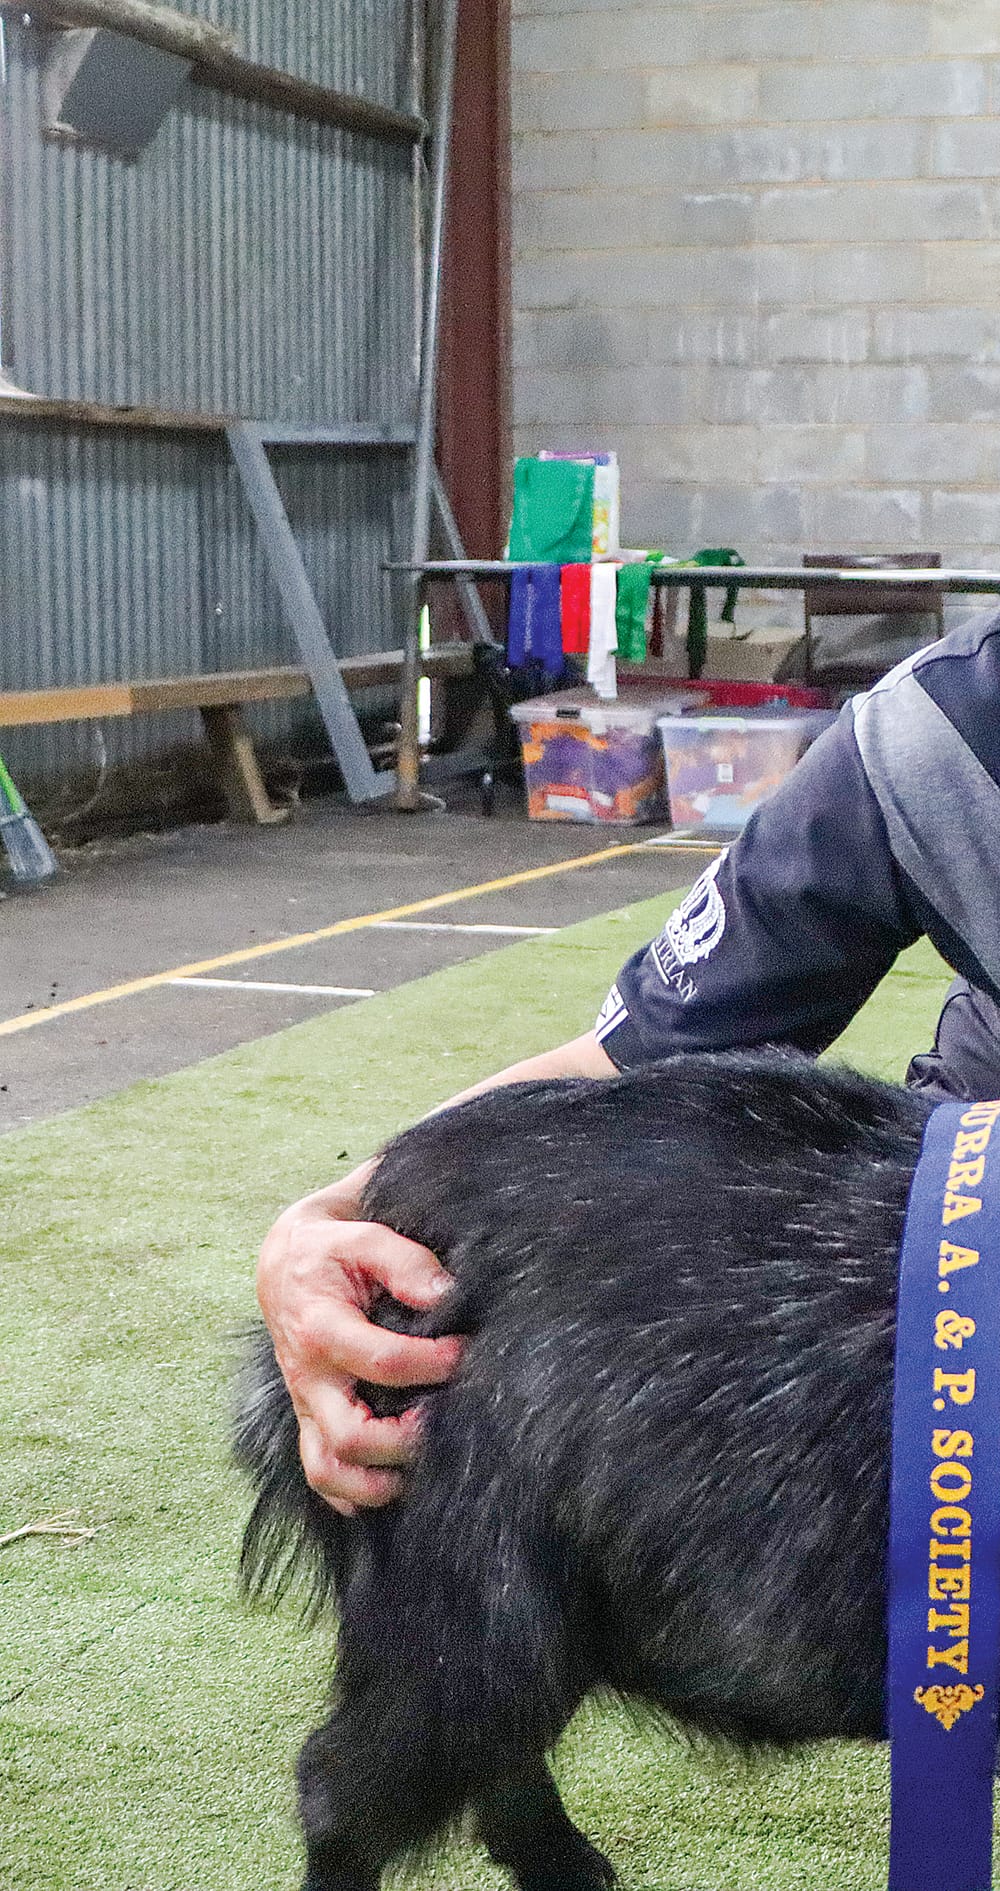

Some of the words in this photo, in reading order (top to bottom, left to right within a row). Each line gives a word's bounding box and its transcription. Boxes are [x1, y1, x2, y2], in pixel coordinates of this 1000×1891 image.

[938, 1240, 980, 1293] A.
[934, 1309, 976, 1350] &
[933, 1367, 976, 1411] P.
[926, 1428, 974, 1674] SOCIETY
